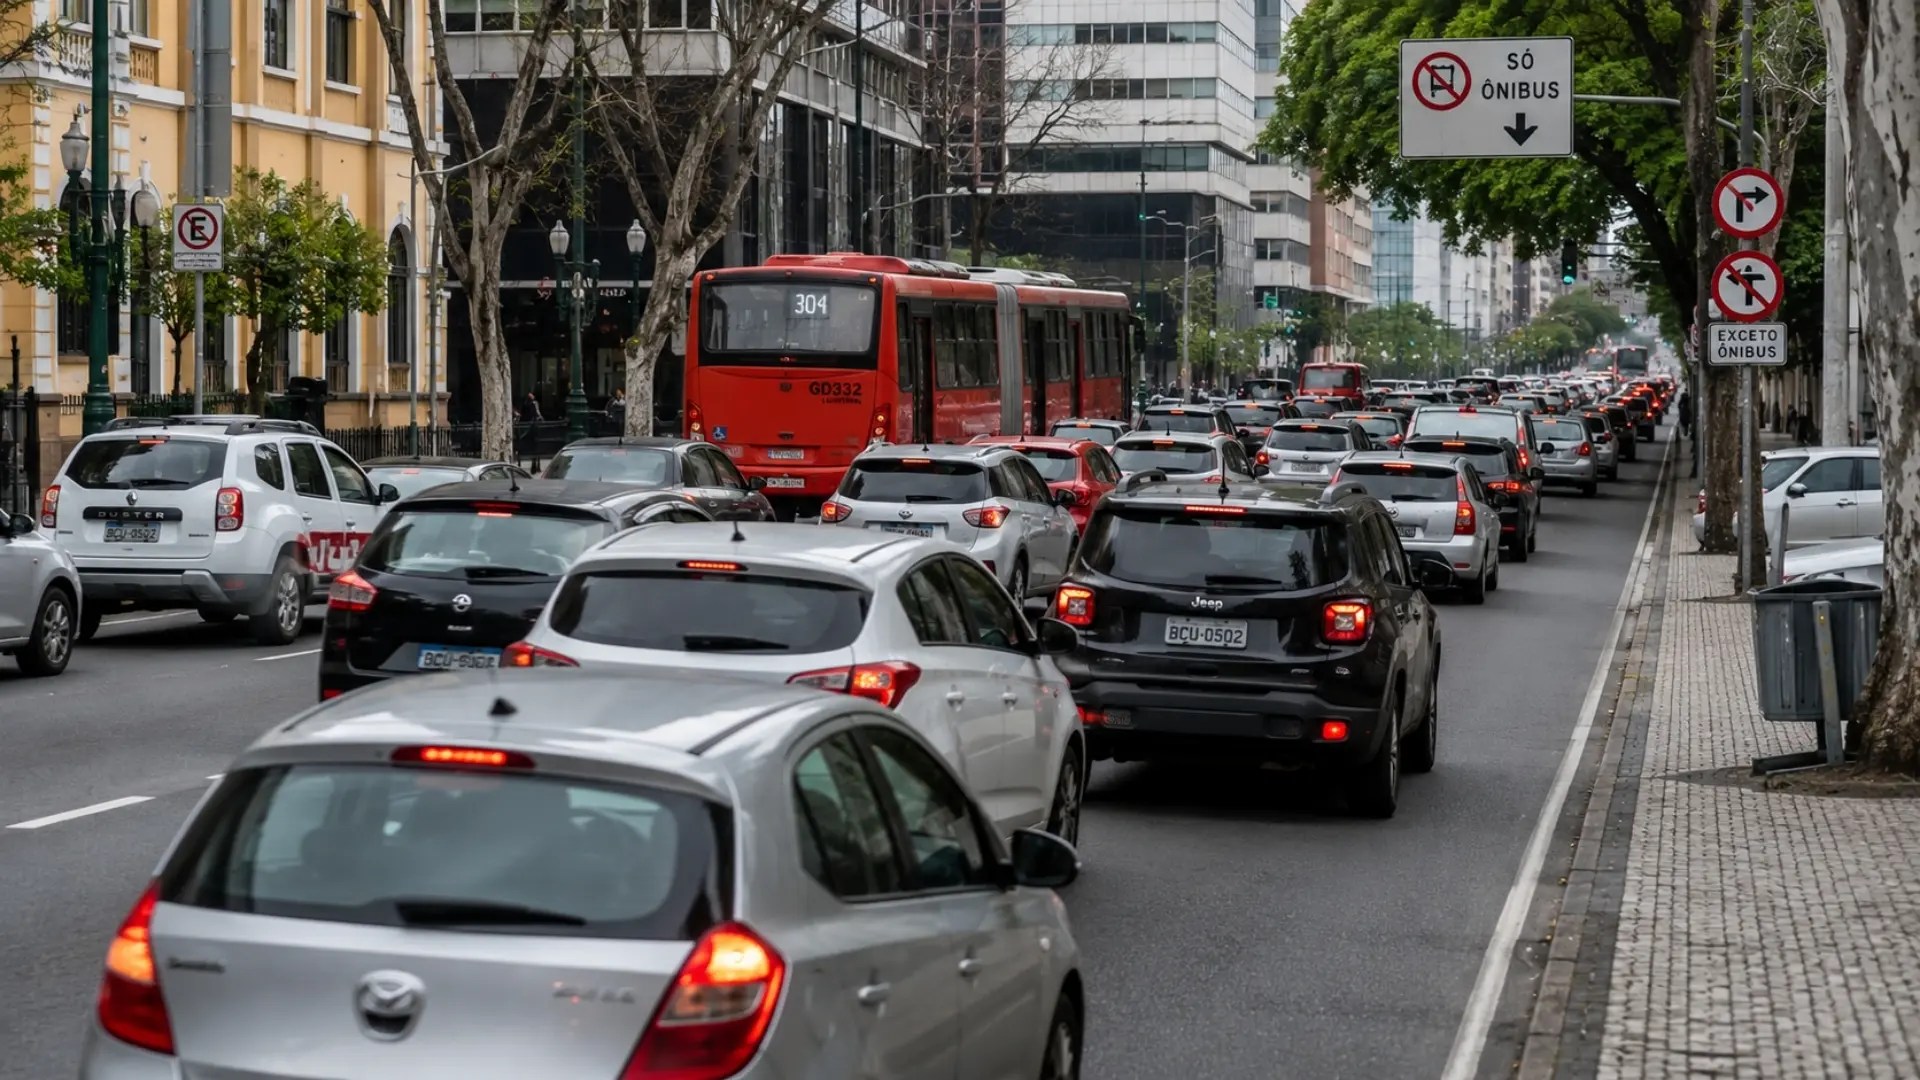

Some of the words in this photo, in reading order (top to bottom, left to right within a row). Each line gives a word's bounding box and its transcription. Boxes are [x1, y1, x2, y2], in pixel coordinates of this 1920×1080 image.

[1507, 48, 1534, 70] SÓ
[1481, 78, 1559, 100] ÔNIBUS
[190, 216, 207, 241] E
[794, 293, 827, 314] 304
[1718, 329, 1778, 341] EXCETO
[1718, 342, 1777, 358] ÔNIBUS
[809, 381, 862, 396] GD332
[98, 511, 164, 519] DUSTER
[1191, 596, 1223, 611] Jeep
